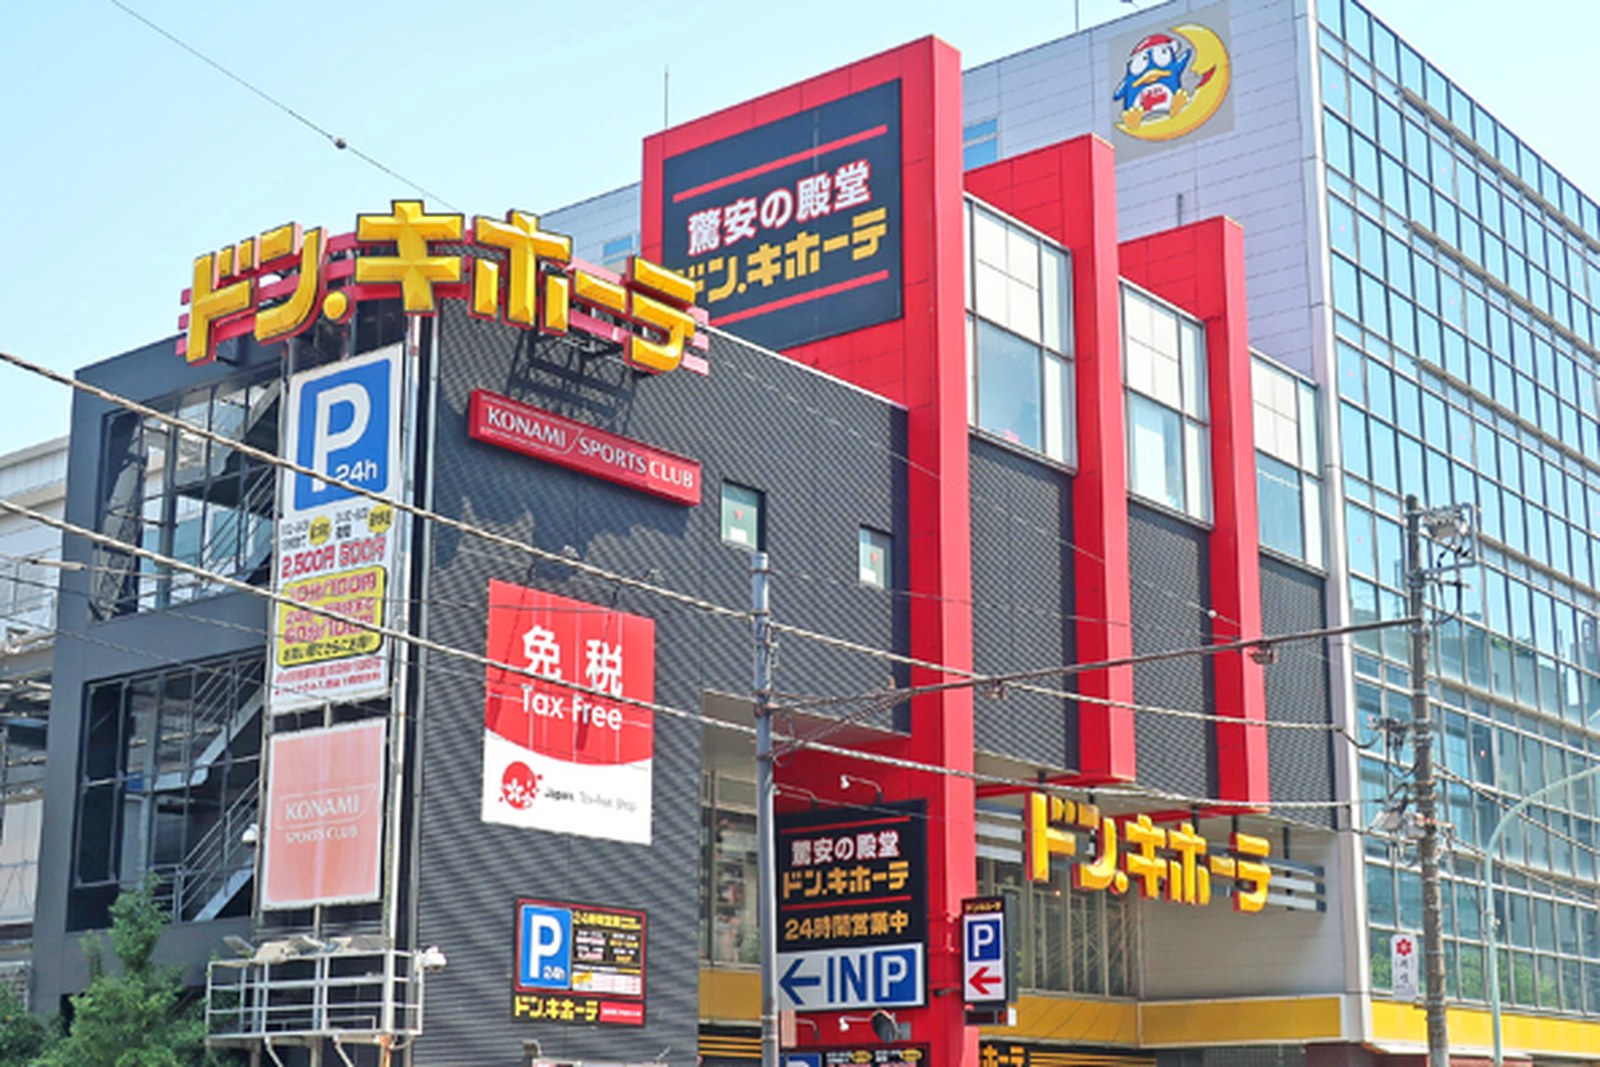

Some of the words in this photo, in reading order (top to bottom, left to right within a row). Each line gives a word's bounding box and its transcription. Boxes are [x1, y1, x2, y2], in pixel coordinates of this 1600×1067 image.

[688, 159, 871, 256] 驚安の殿堂
[312, 383, 370, 492] P
[487, 406, 567, 448] KONAMI
[579, 436, 646, 474] SPORTS
[649, 459, 694, 489] CLUB
[335, 459, 378, 484] 24h
[522, 624, 623, 697] 免税
[520, 683, 564, 719] Tax
[571, 693, 623, 730] Free
[285, 795, 360, 821] KONAMI
[284, 827, 325, 845] SPORTS
[326, 826, 358, 839] CLUB
[791, 830, 900, 866] 驚安の殿堂
[784, 909, 909, 941] 24時間営業中
[971, 923, 995, 958] P
[529, 914, 563, 979] P
